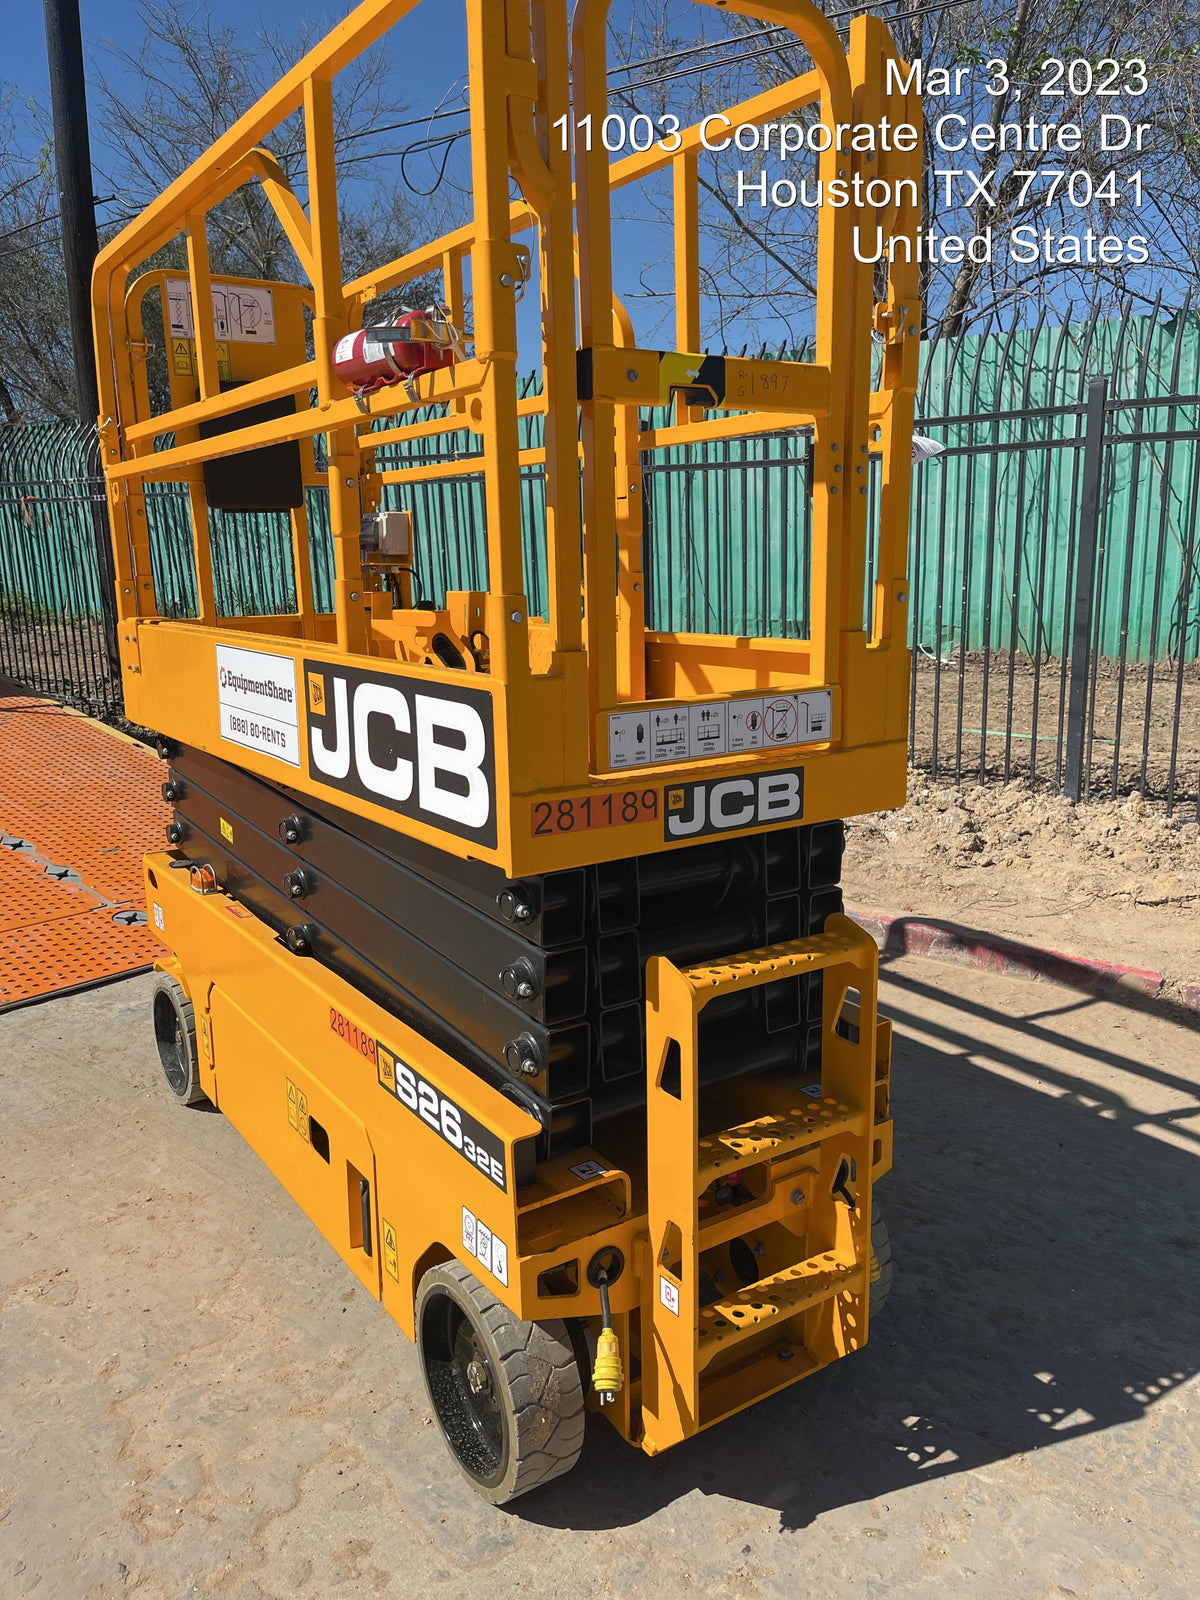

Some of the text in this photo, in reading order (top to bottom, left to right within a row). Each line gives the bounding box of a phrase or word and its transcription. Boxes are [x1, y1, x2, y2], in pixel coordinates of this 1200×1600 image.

[227, 670, 293, 703] EquipmentShare
[229, 714, 286, 748] (888) 80-RENTS
[310, 677, 490, 828] JCB
[534, 789, 658, 836] 281189
[668, 772, 801, 836] JCB
[330, 1007, 377, 1065] 281189
